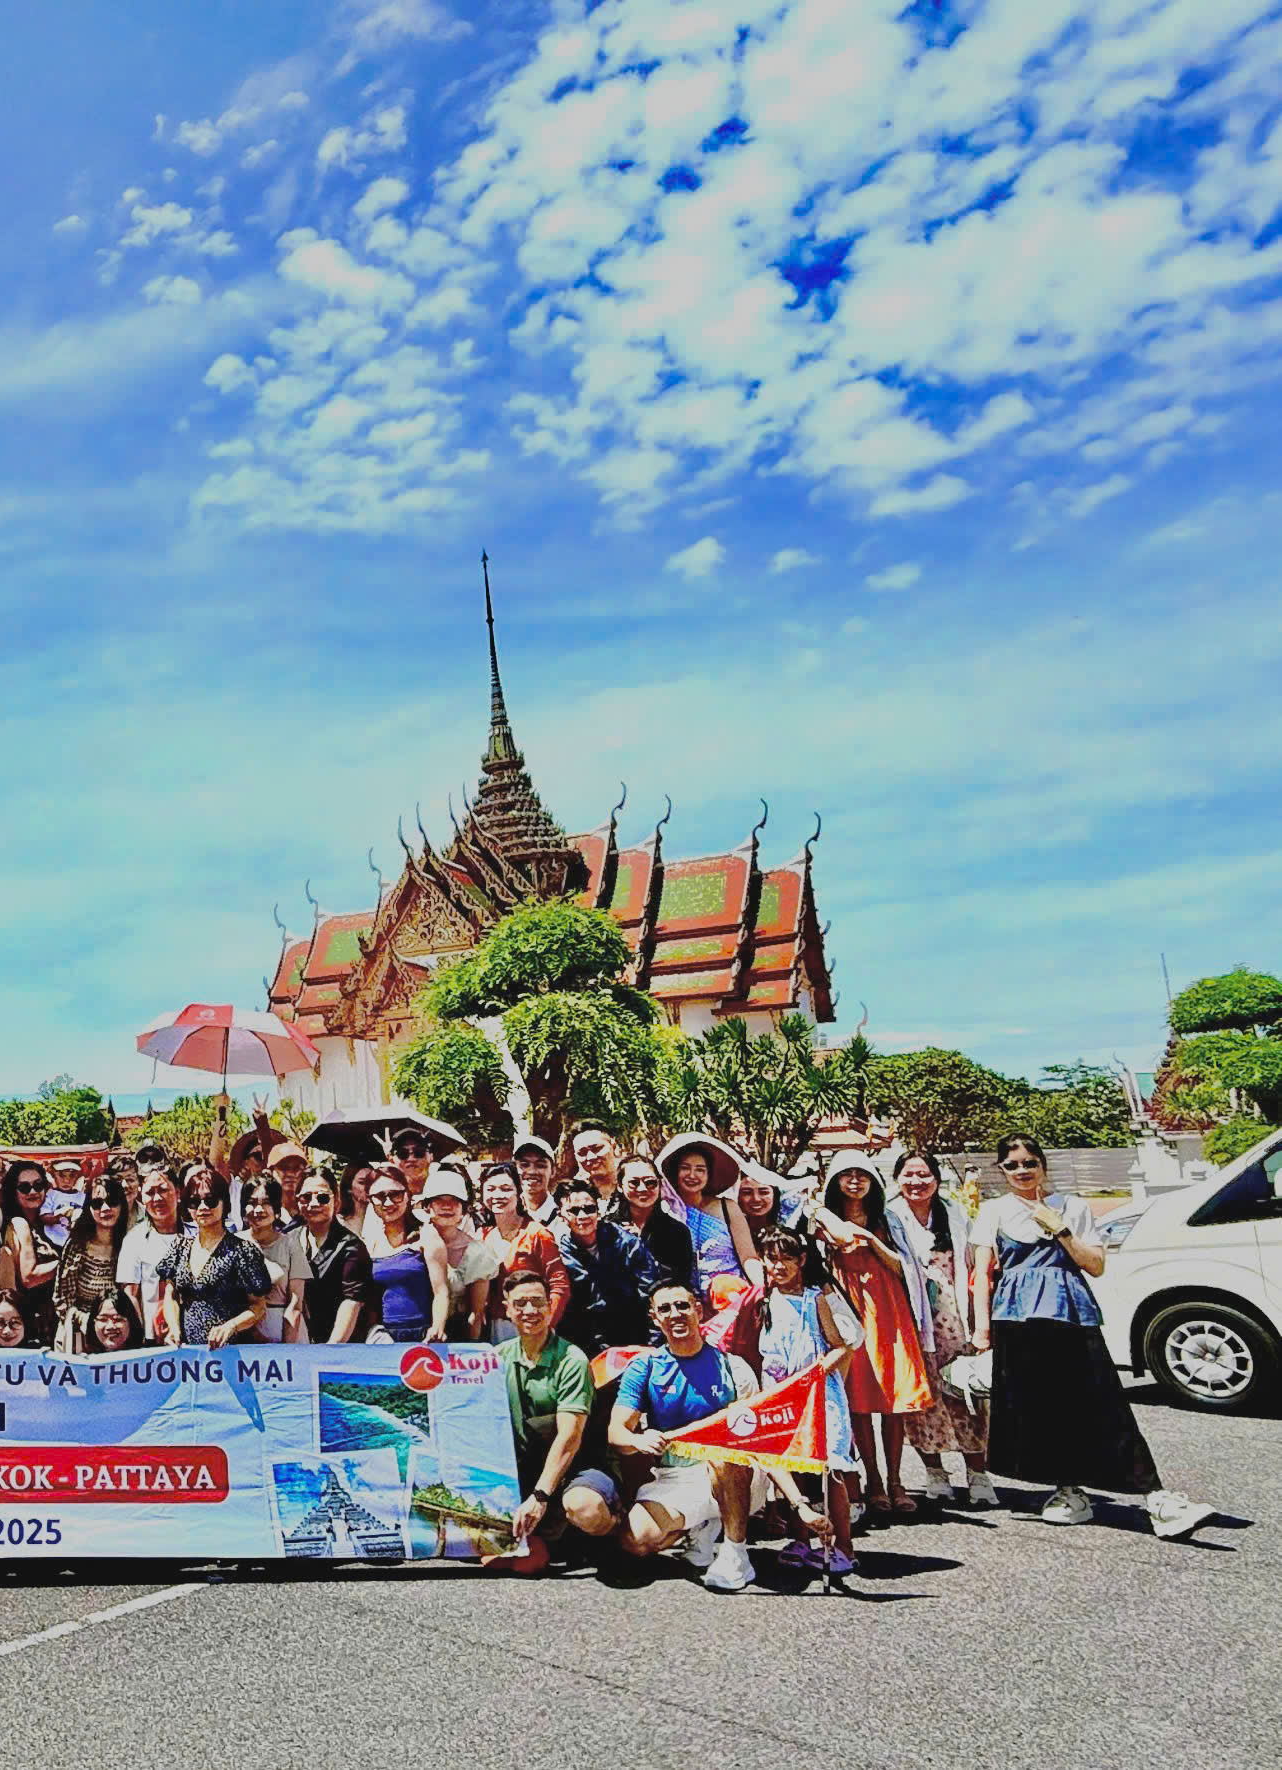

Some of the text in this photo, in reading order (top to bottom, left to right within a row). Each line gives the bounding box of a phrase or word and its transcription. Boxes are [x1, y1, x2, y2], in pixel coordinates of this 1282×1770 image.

[37, 1360, 78, 1387] VÀ
[89, 1357, 224, 1385] THƯƠNG
[237, 1358, 294, 1389] MẠI
[447, 1353, 500, 1375] Koji
[450, 1375, 485, 1385] Travel
[74, 1465, 216, 1491] PATTAYA
